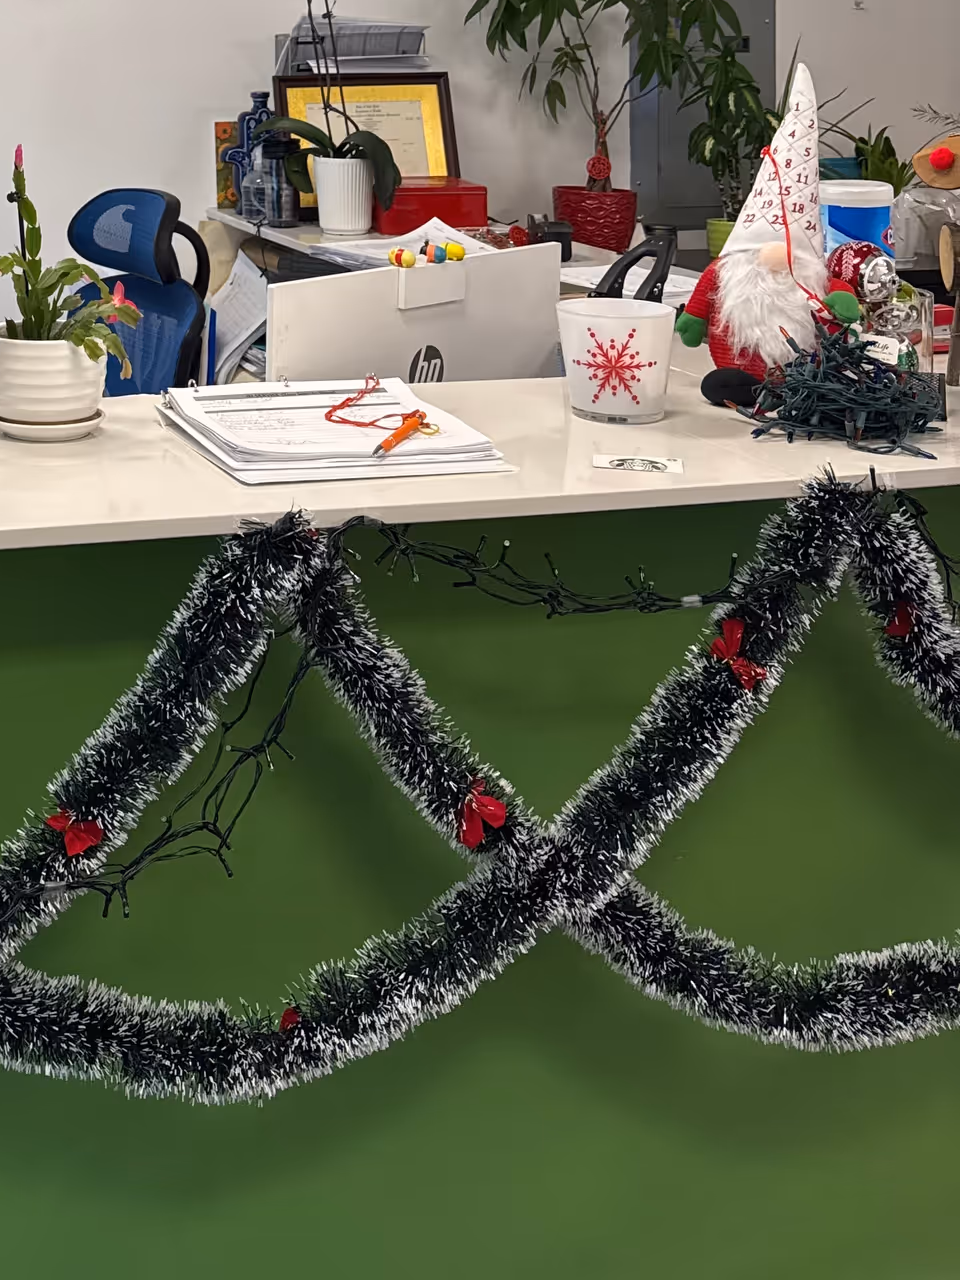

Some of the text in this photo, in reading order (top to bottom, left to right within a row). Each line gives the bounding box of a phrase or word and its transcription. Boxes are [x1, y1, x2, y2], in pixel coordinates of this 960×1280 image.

[794, 102, 800, 111] 1
[808, 119, 815, 129] 2
[788, 129, 796, 139] 4
[804, 147, 812, 157] 5
[785, 159, 792, 168] 8
[796, 173, 809, 186] 11
[761, 200, 804, 214] 19 18
[743, 214, 756, 223] 22
[804, 220, 817, 232] 24
